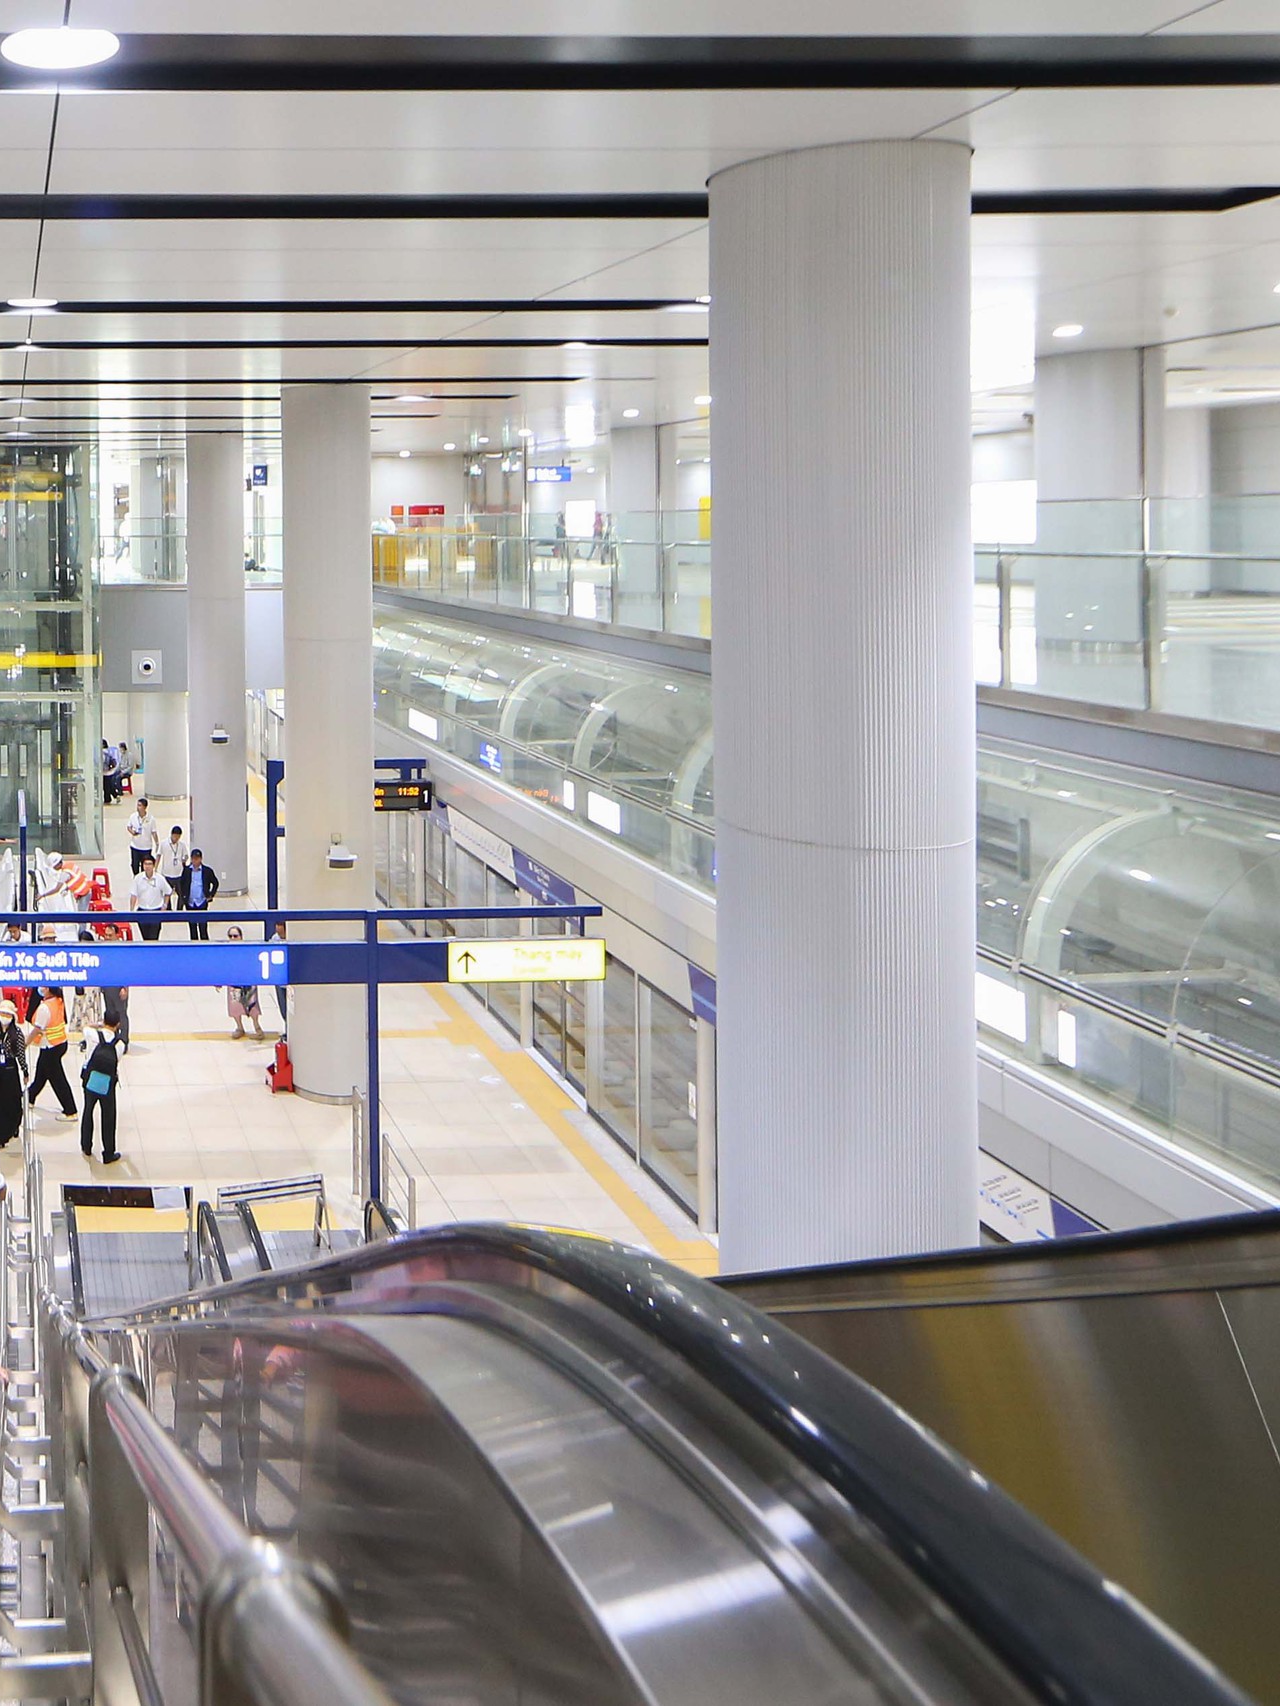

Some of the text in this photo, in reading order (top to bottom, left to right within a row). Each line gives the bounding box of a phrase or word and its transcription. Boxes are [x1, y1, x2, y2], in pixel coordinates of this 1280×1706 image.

[423, 790, 429, 803] 1
[15, 952, 34, 967] Xe
[70, 951, 100, 967] Tiên
[258, 951, 269, 980] 1
[21, 969, 42, 981] Tien
[43, 968, 88, 981] Terminal
